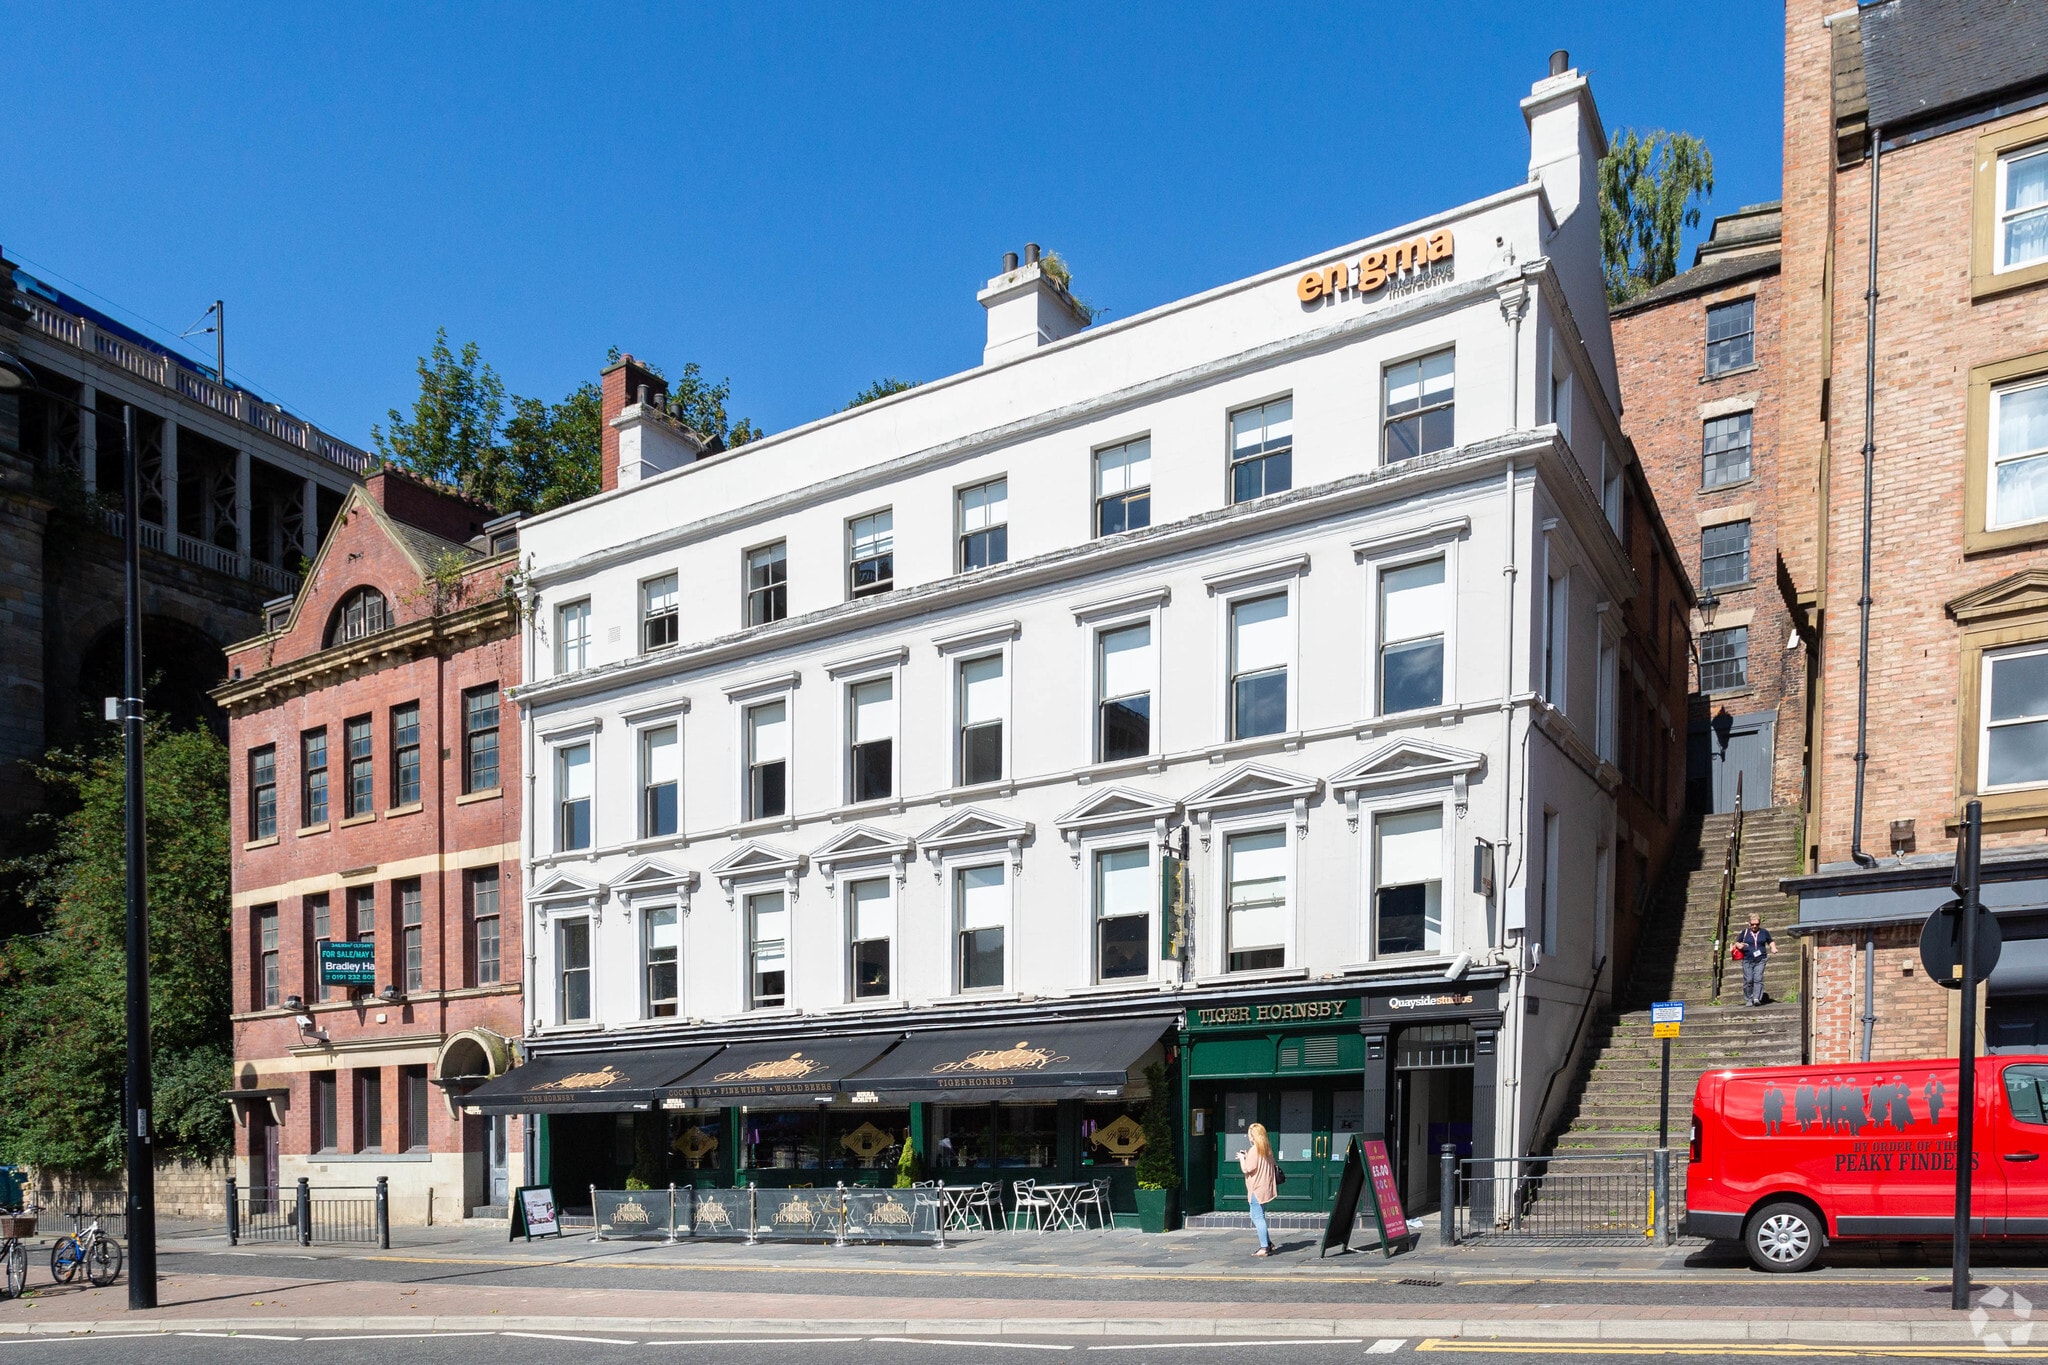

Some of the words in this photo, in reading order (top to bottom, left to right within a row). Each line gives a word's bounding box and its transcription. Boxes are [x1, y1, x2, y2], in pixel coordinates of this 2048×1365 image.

[1297, 229, 1455, 302] enigma
[1387, 264, 1455, 292] interactive
[336, 950, 370, 958] SALE/MAY
[326, 962, 360, 972] Bradley
[1198, 1006, 1252, 1024] TIGER
[1256, 1000, 1347, 1021] HORNSBY
[967, 1048, 1056, 1061] TIGER
[938, 1078, 967, 1087] TIGER
[968, 1077, 1015, 1086] HORNSBY
[668, 1089, 711, 1097] COCKTAILS
[775, 1084, 803, 1092] WORLD
[804, 1083, 832, 1092] BEERS
[1854, 1142, 1868, 1152] BY
[1872, 1141, 1912, 1152] ORDER
[1916, 1140, 1932, 1151] OF
[1835, 1152, 1894, 1172] PEAKY
[1898, 1152, 1980, 1170] FINDES
[1372, 1164, 1389, 1178] £5.00
[616, 1203, 647, 1212] TIGER
[779, 1202, 814, 1213] TIGER
[872, 1202, 910, 1213] TIGER
[610, 1211, 654, 1224] HORNSBY
[771, 1212, 821, 1226] HORNSBY
[864, 1213, 918, 1226] HORNSBY
